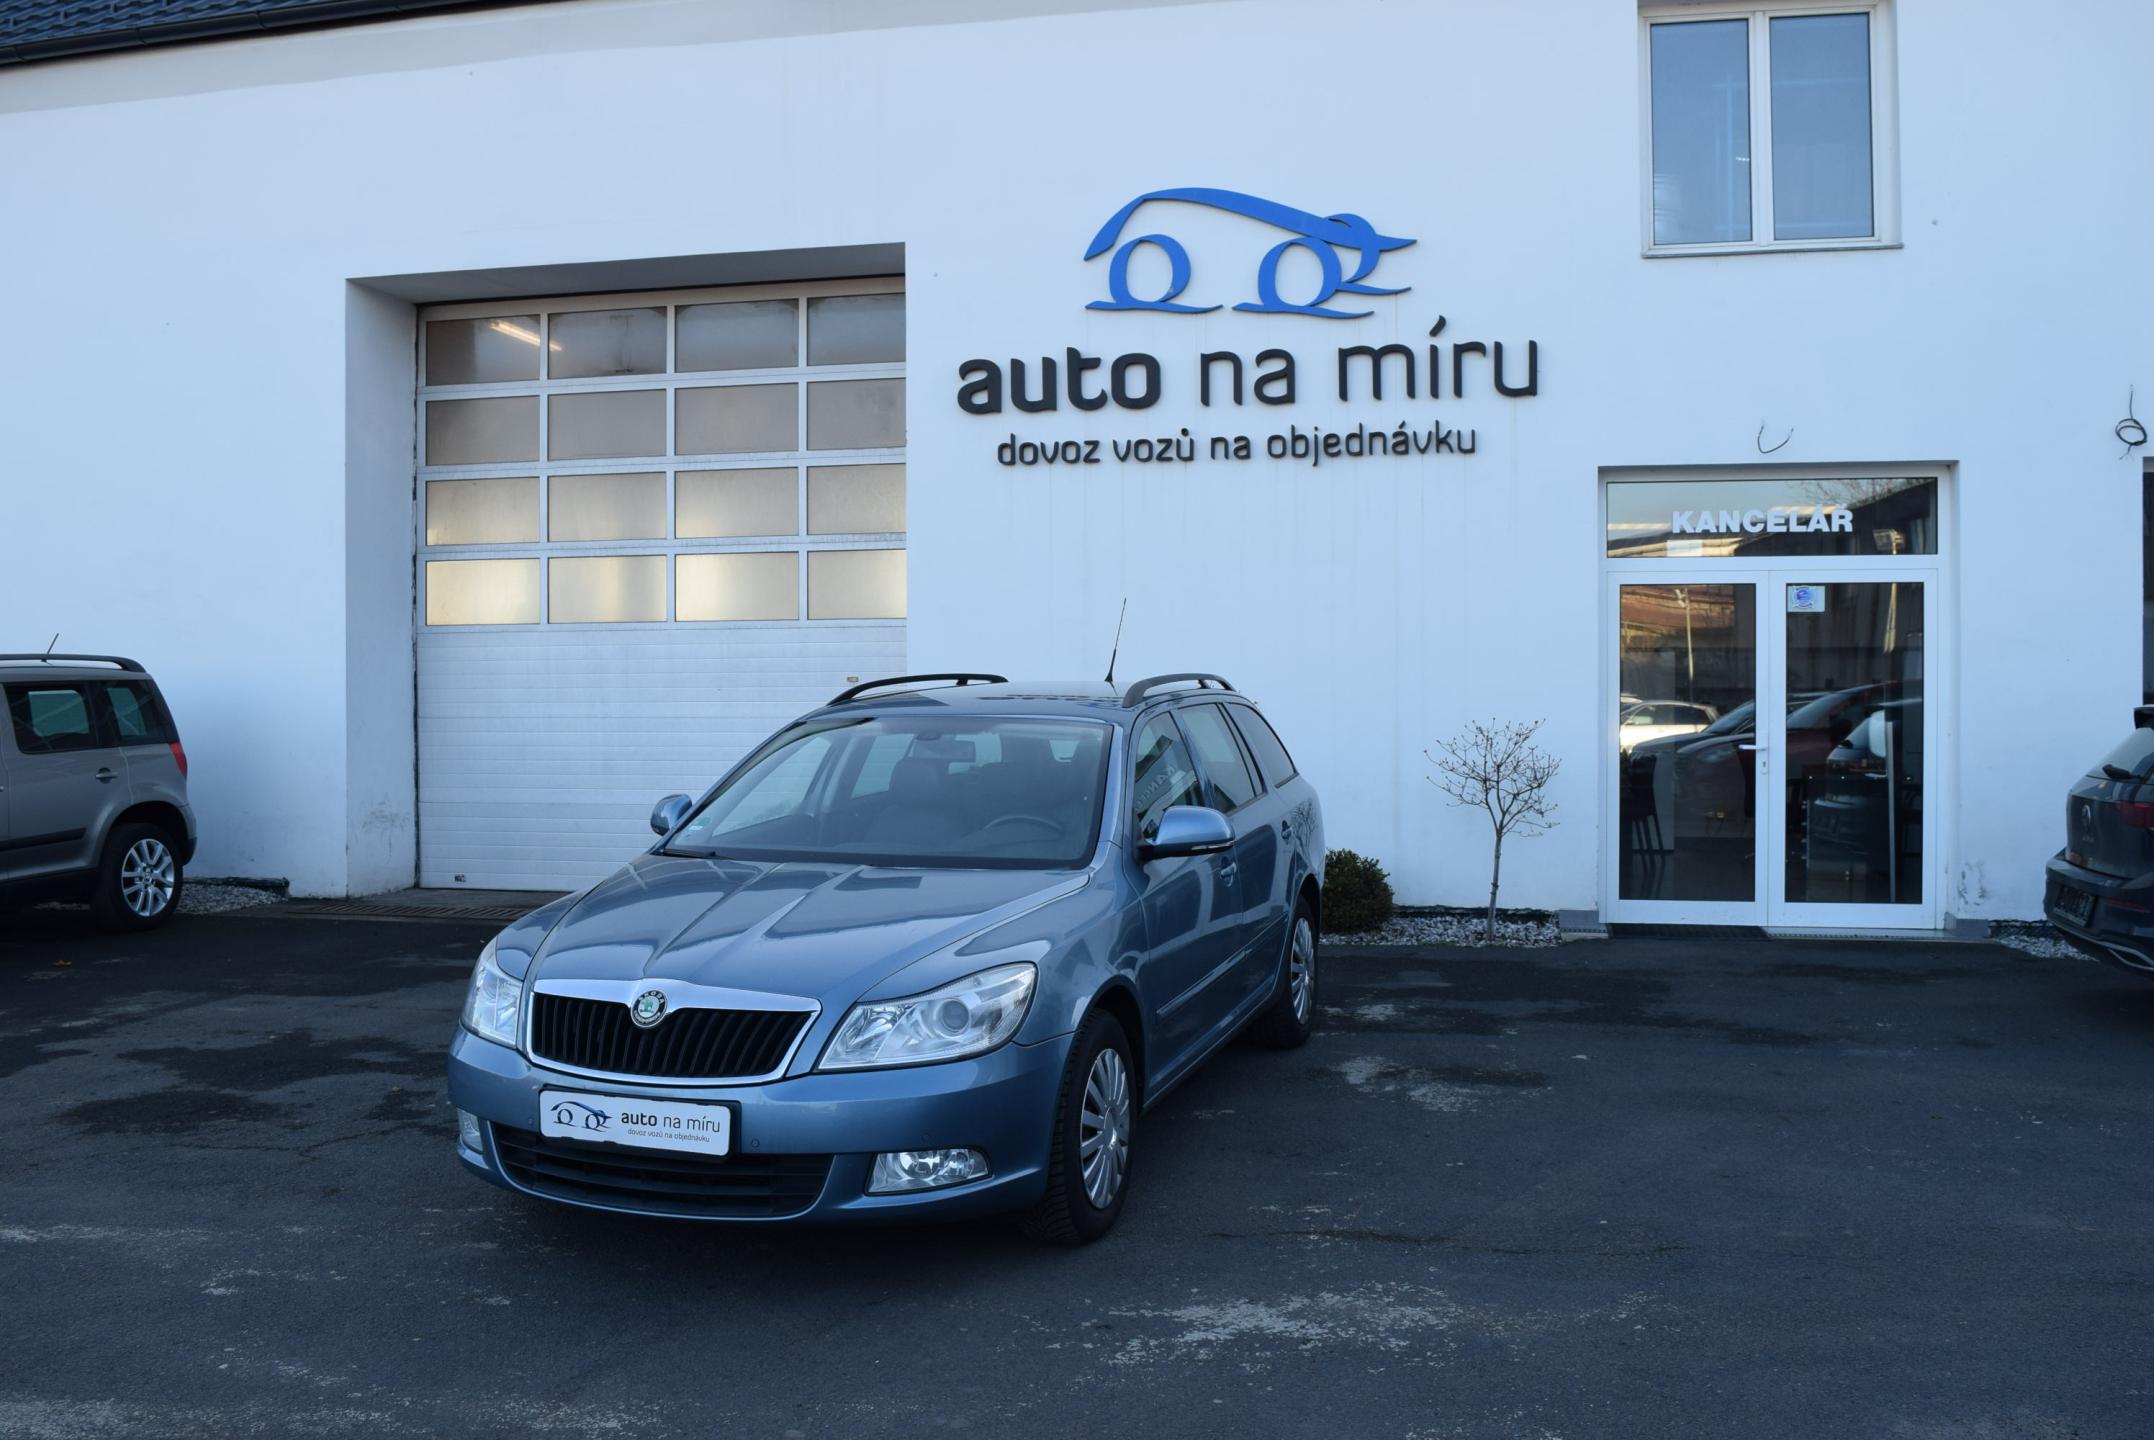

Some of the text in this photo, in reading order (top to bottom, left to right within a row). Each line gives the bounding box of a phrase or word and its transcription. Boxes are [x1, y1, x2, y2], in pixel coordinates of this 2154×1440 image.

[957, 314, 1539, 415] auto na míru
[997, 420, 1476, 467] dovoz vozů na objednávku
[1672, 503, 1853, 533] KANCELÁŘ
[621, 1112, 721, 1133] auto na míru
